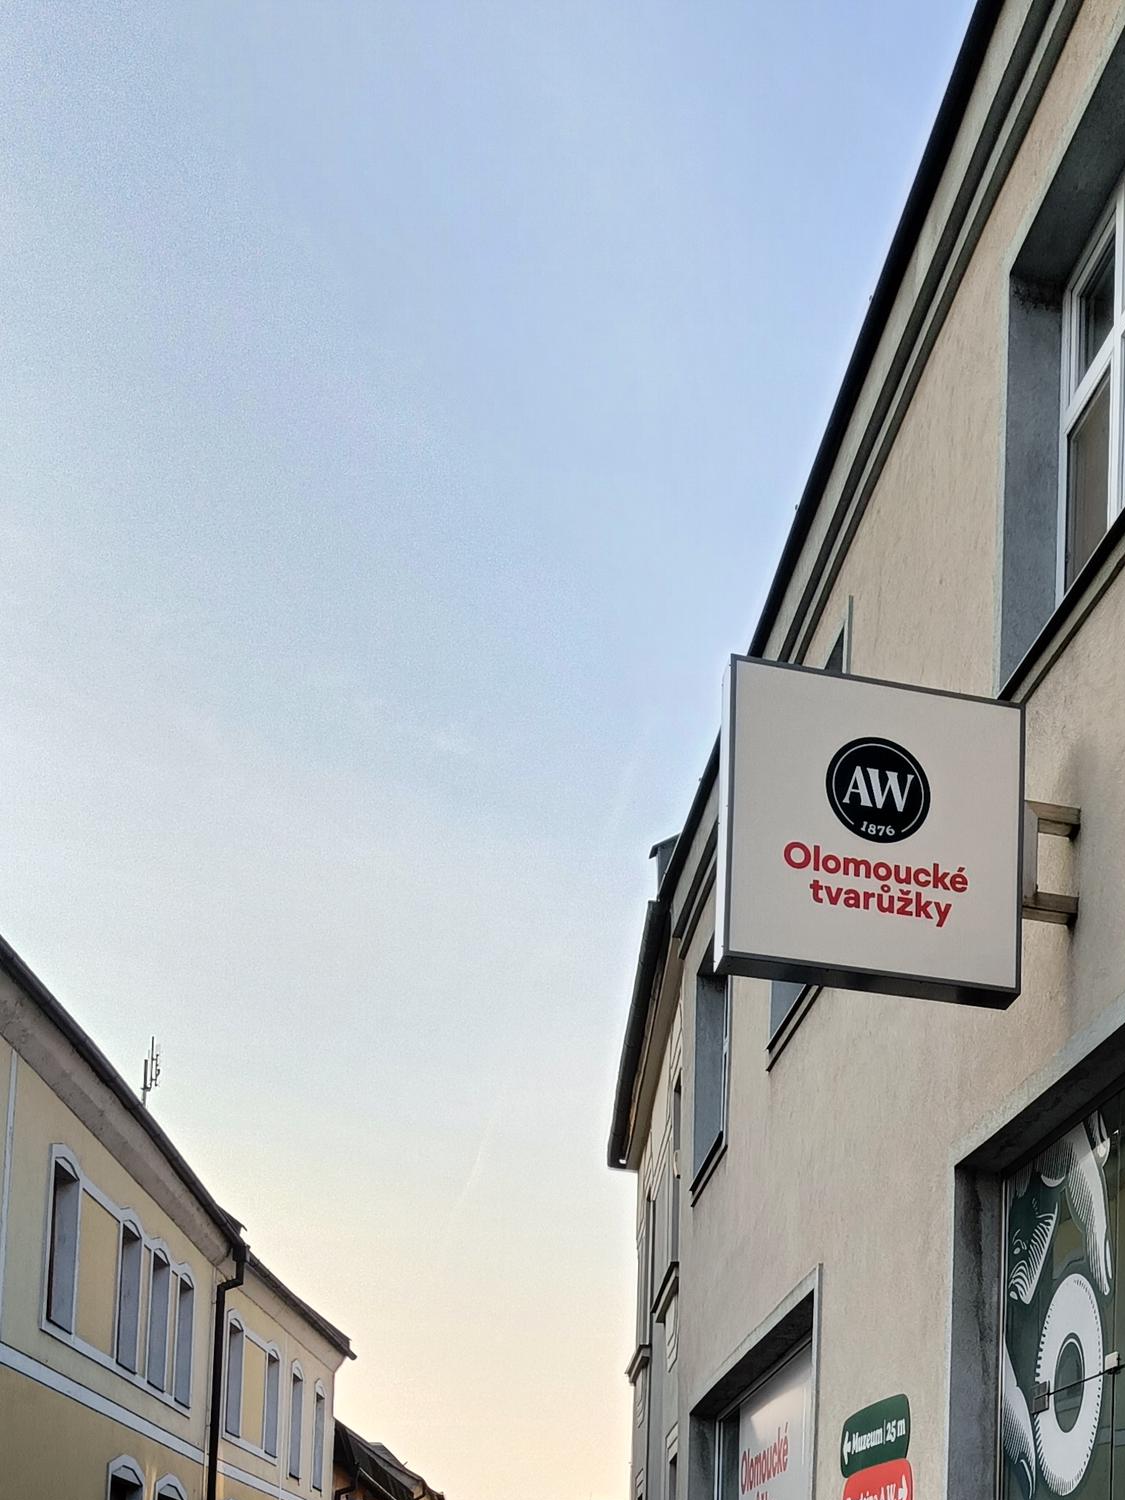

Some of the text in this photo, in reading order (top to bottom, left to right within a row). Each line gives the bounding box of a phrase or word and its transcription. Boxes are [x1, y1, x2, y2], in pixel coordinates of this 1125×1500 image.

[842, 765, 914, 812] AW
[860, 820, 895, 837] 1876
[783, 841, 969, 893] Olomoucké
[809, 879, 952, 928] tvarůžky
[741, 1421, 789, 1495] Olomoucké
[851, 1418, 906, 1455] Muzeum 25 m
